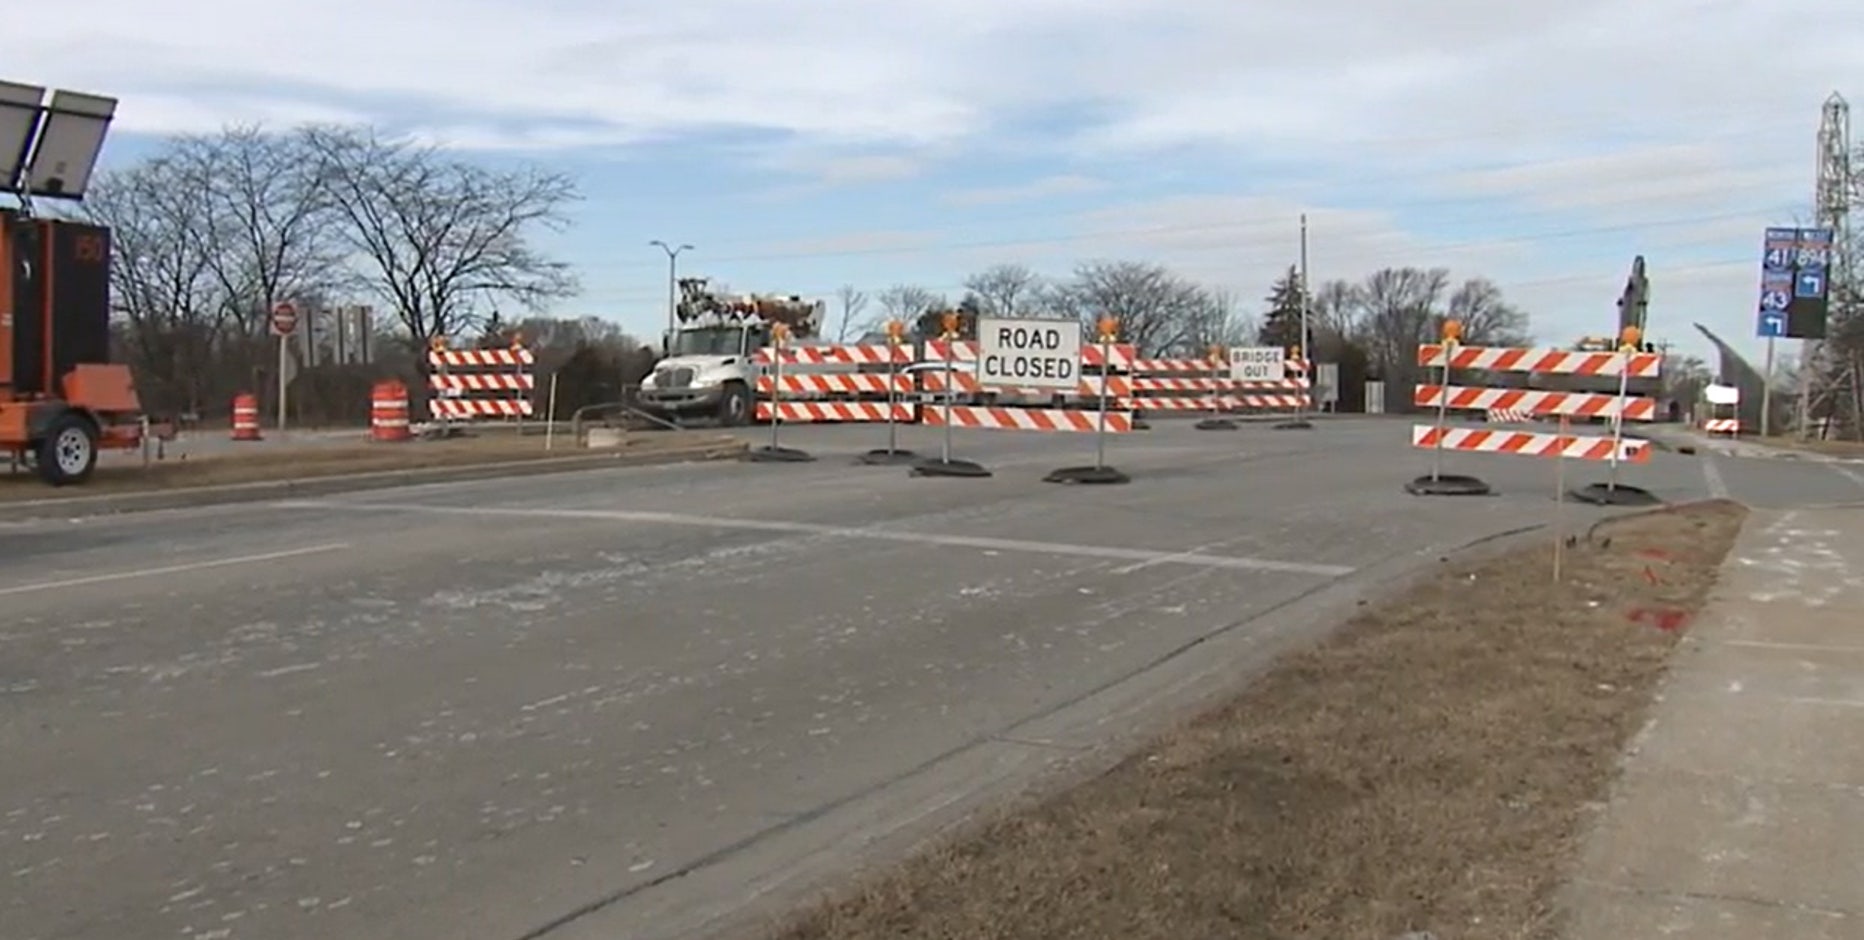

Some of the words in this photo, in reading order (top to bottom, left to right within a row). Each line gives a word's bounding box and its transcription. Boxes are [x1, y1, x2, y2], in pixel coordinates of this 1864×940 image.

[1767, 249, 1789, 265] 41
[1763, 291, 1788, 309] 43
[999, 327, 1060, 349] ROAD
[1233, 351, 1279, 363] BRIDGE
[985, 355, 1072, 379] CLOSED
[1244, 365, 1268, 377] OUT
